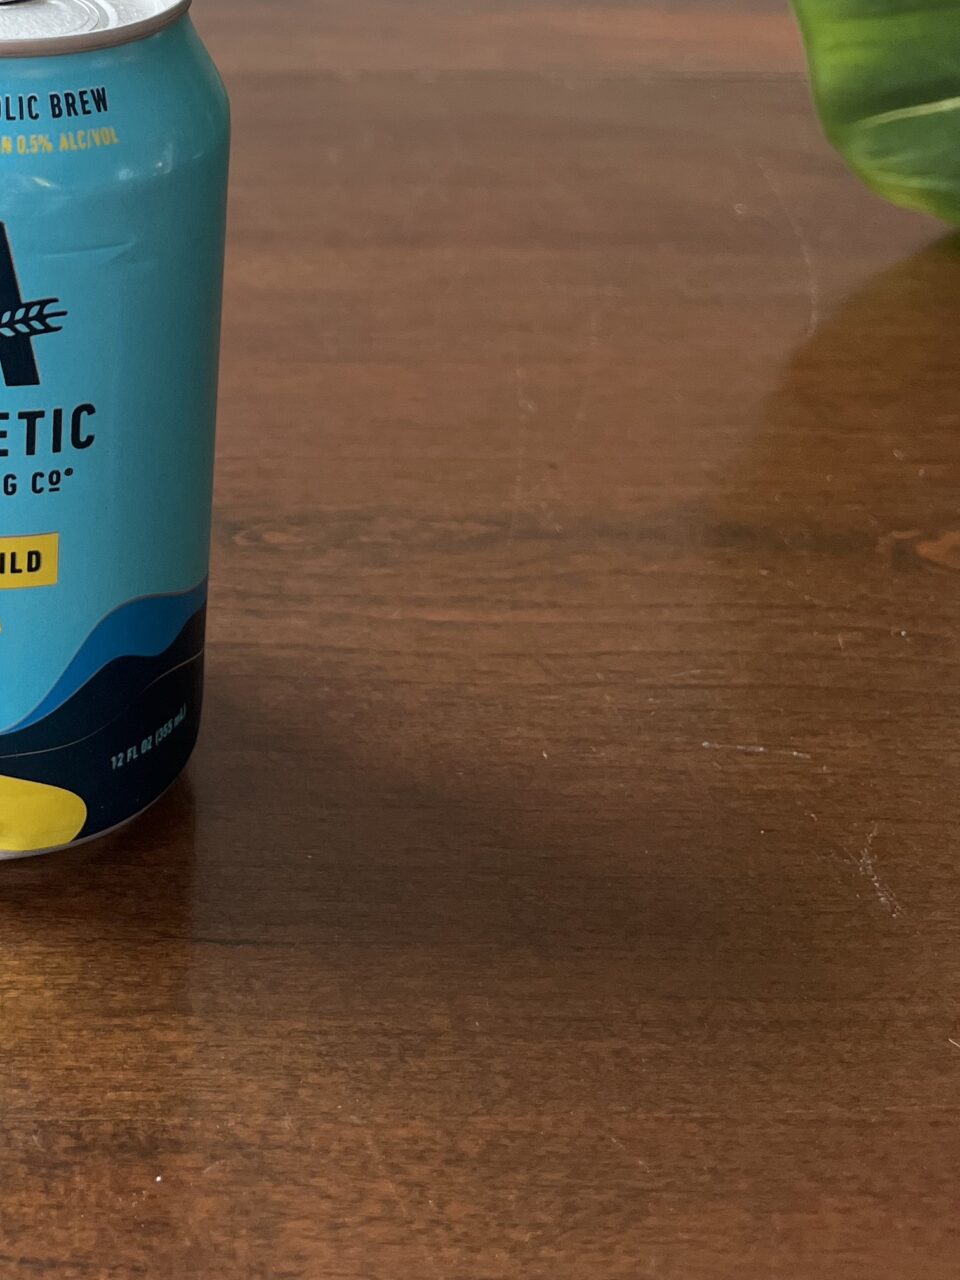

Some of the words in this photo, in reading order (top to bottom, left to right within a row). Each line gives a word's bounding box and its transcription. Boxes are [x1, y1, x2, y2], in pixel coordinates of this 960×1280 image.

[50, 86, 109, 120] BREW
[17, 136, 53, 154] 0.5%
[59, 127, 120, 151] ALC/VOL
[110, 752, 124, 770] 12
[127, 745, 138, 762] FL
[141, 735, 153, 754] OZ
